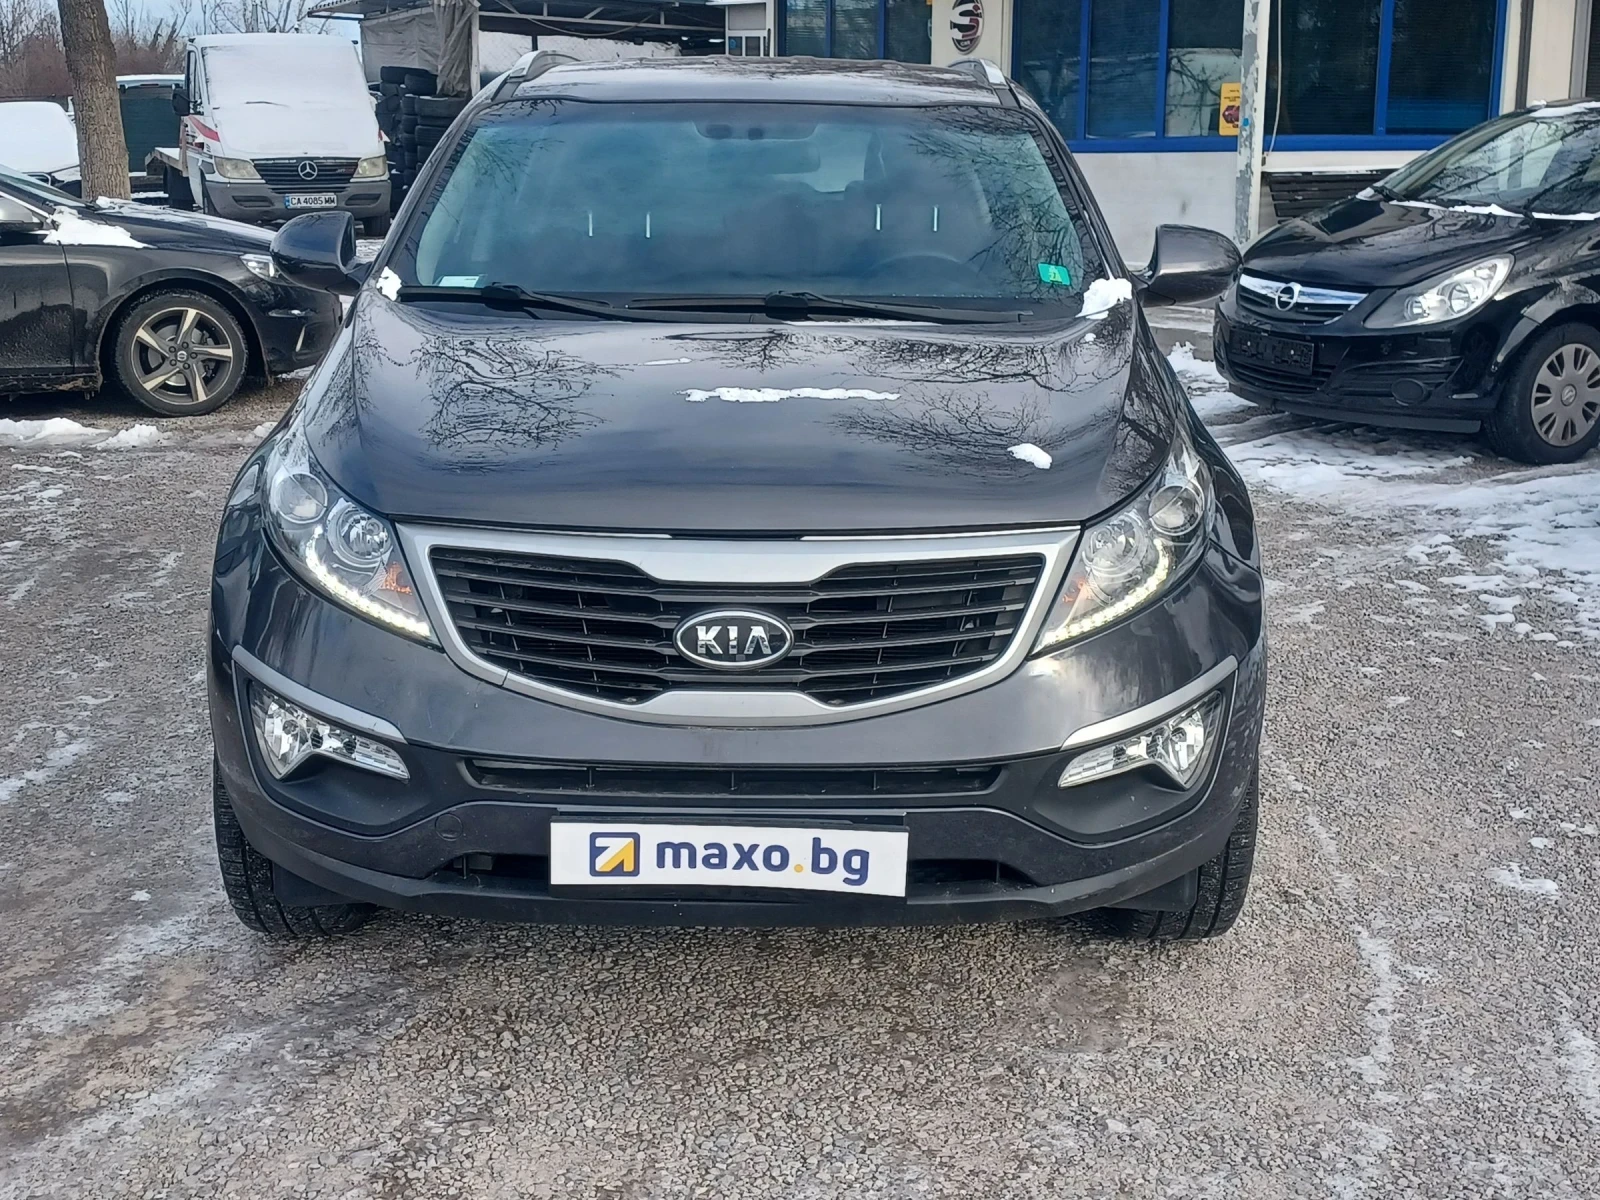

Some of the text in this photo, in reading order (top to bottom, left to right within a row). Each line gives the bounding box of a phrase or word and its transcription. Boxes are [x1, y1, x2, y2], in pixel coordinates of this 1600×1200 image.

[290, 196, 336, 206] CA 4085 MM
[696, 625, 772, 655] KIA
[656, 836, 870, 886] maxo.bg
